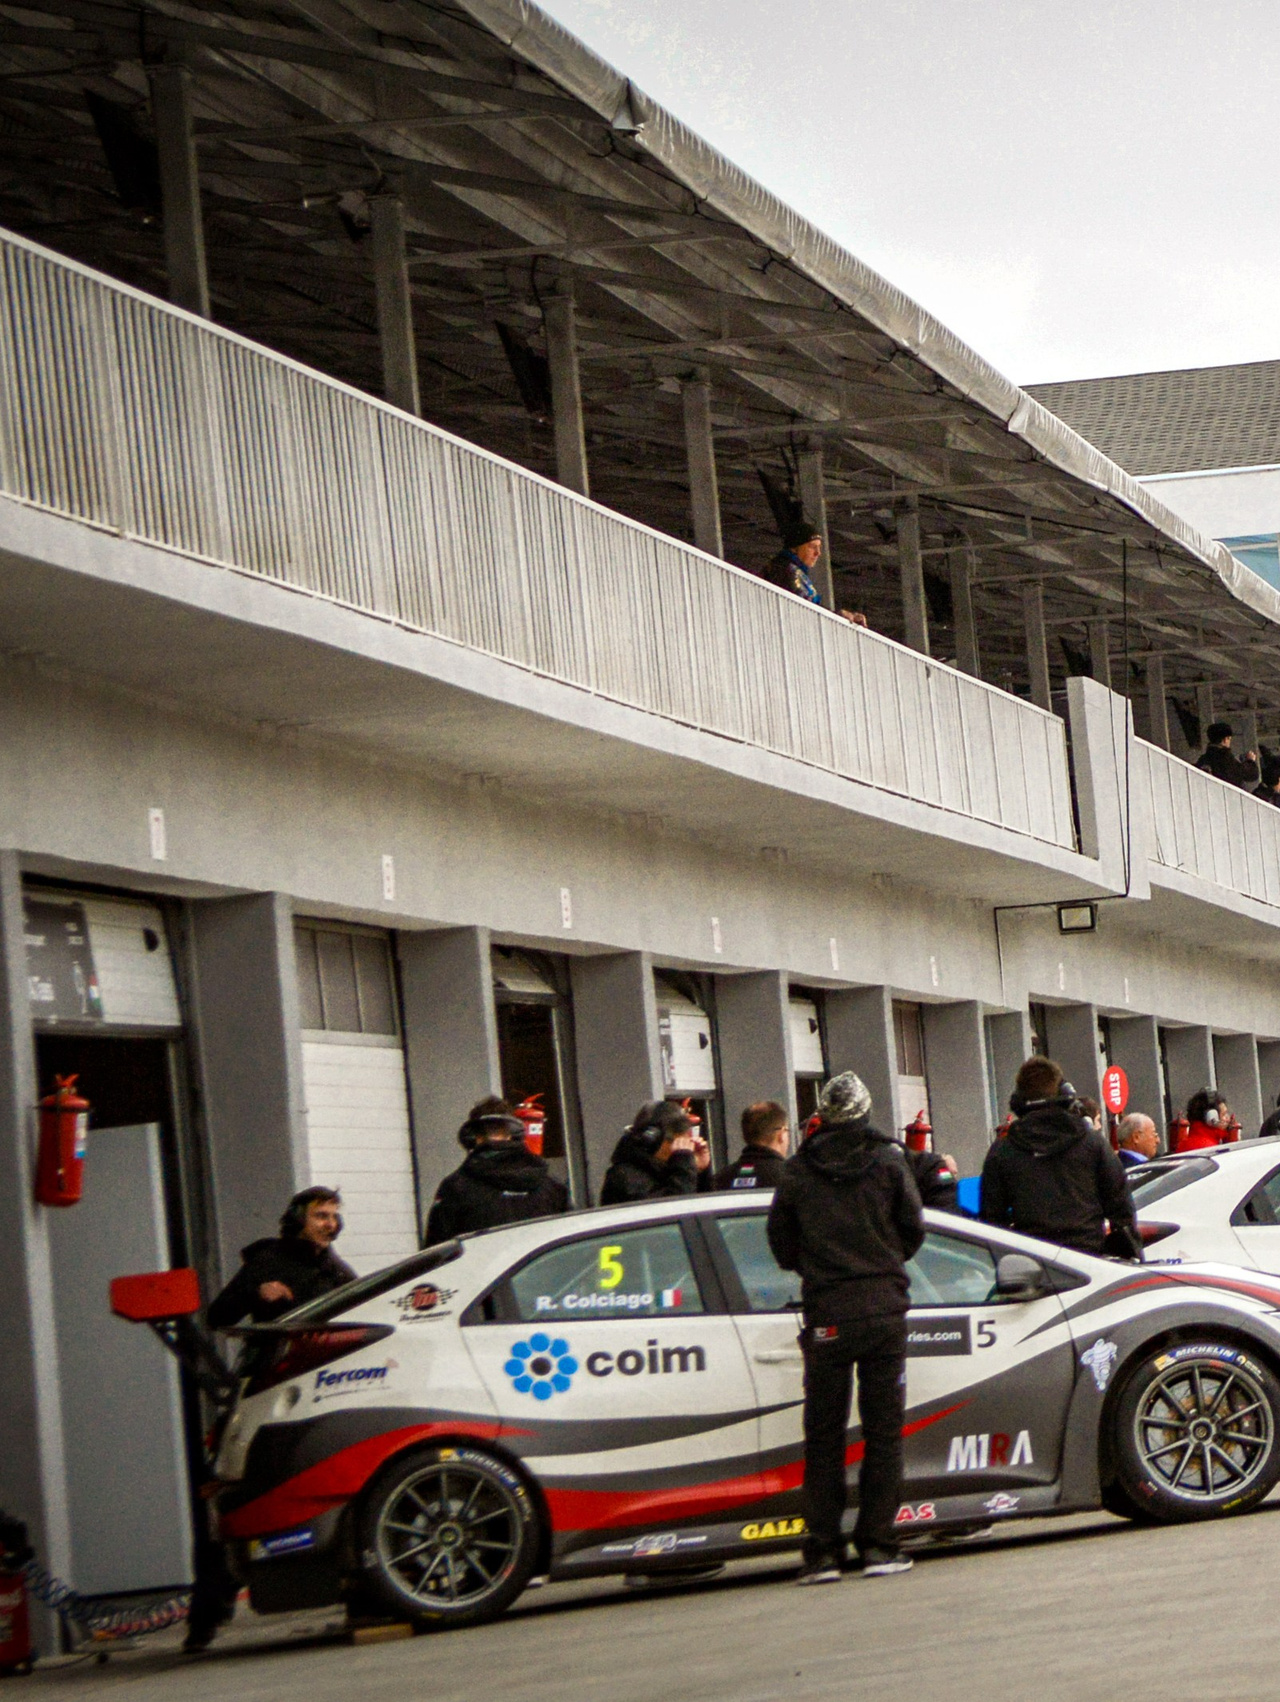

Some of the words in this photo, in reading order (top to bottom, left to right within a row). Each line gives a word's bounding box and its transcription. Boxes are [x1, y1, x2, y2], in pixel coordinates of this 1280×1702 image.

[1109, 1073, 1122, 1105] STOP
[599, 1246, 624, 1289] 5
[536, 1296, 558, 1311] R.
[562, 1292, 655, 1309] Colciago
[907, 1331, 962, 1342] ries.com
[976, 1320, 998, 1348] 5
[586, 1339, 707, 1377] coim
[1176, 1345, 1235, 1357] MICHELIN
[315, 1366, 388, 1389] Fercom
[893, 1502, 937, 1525] AS
